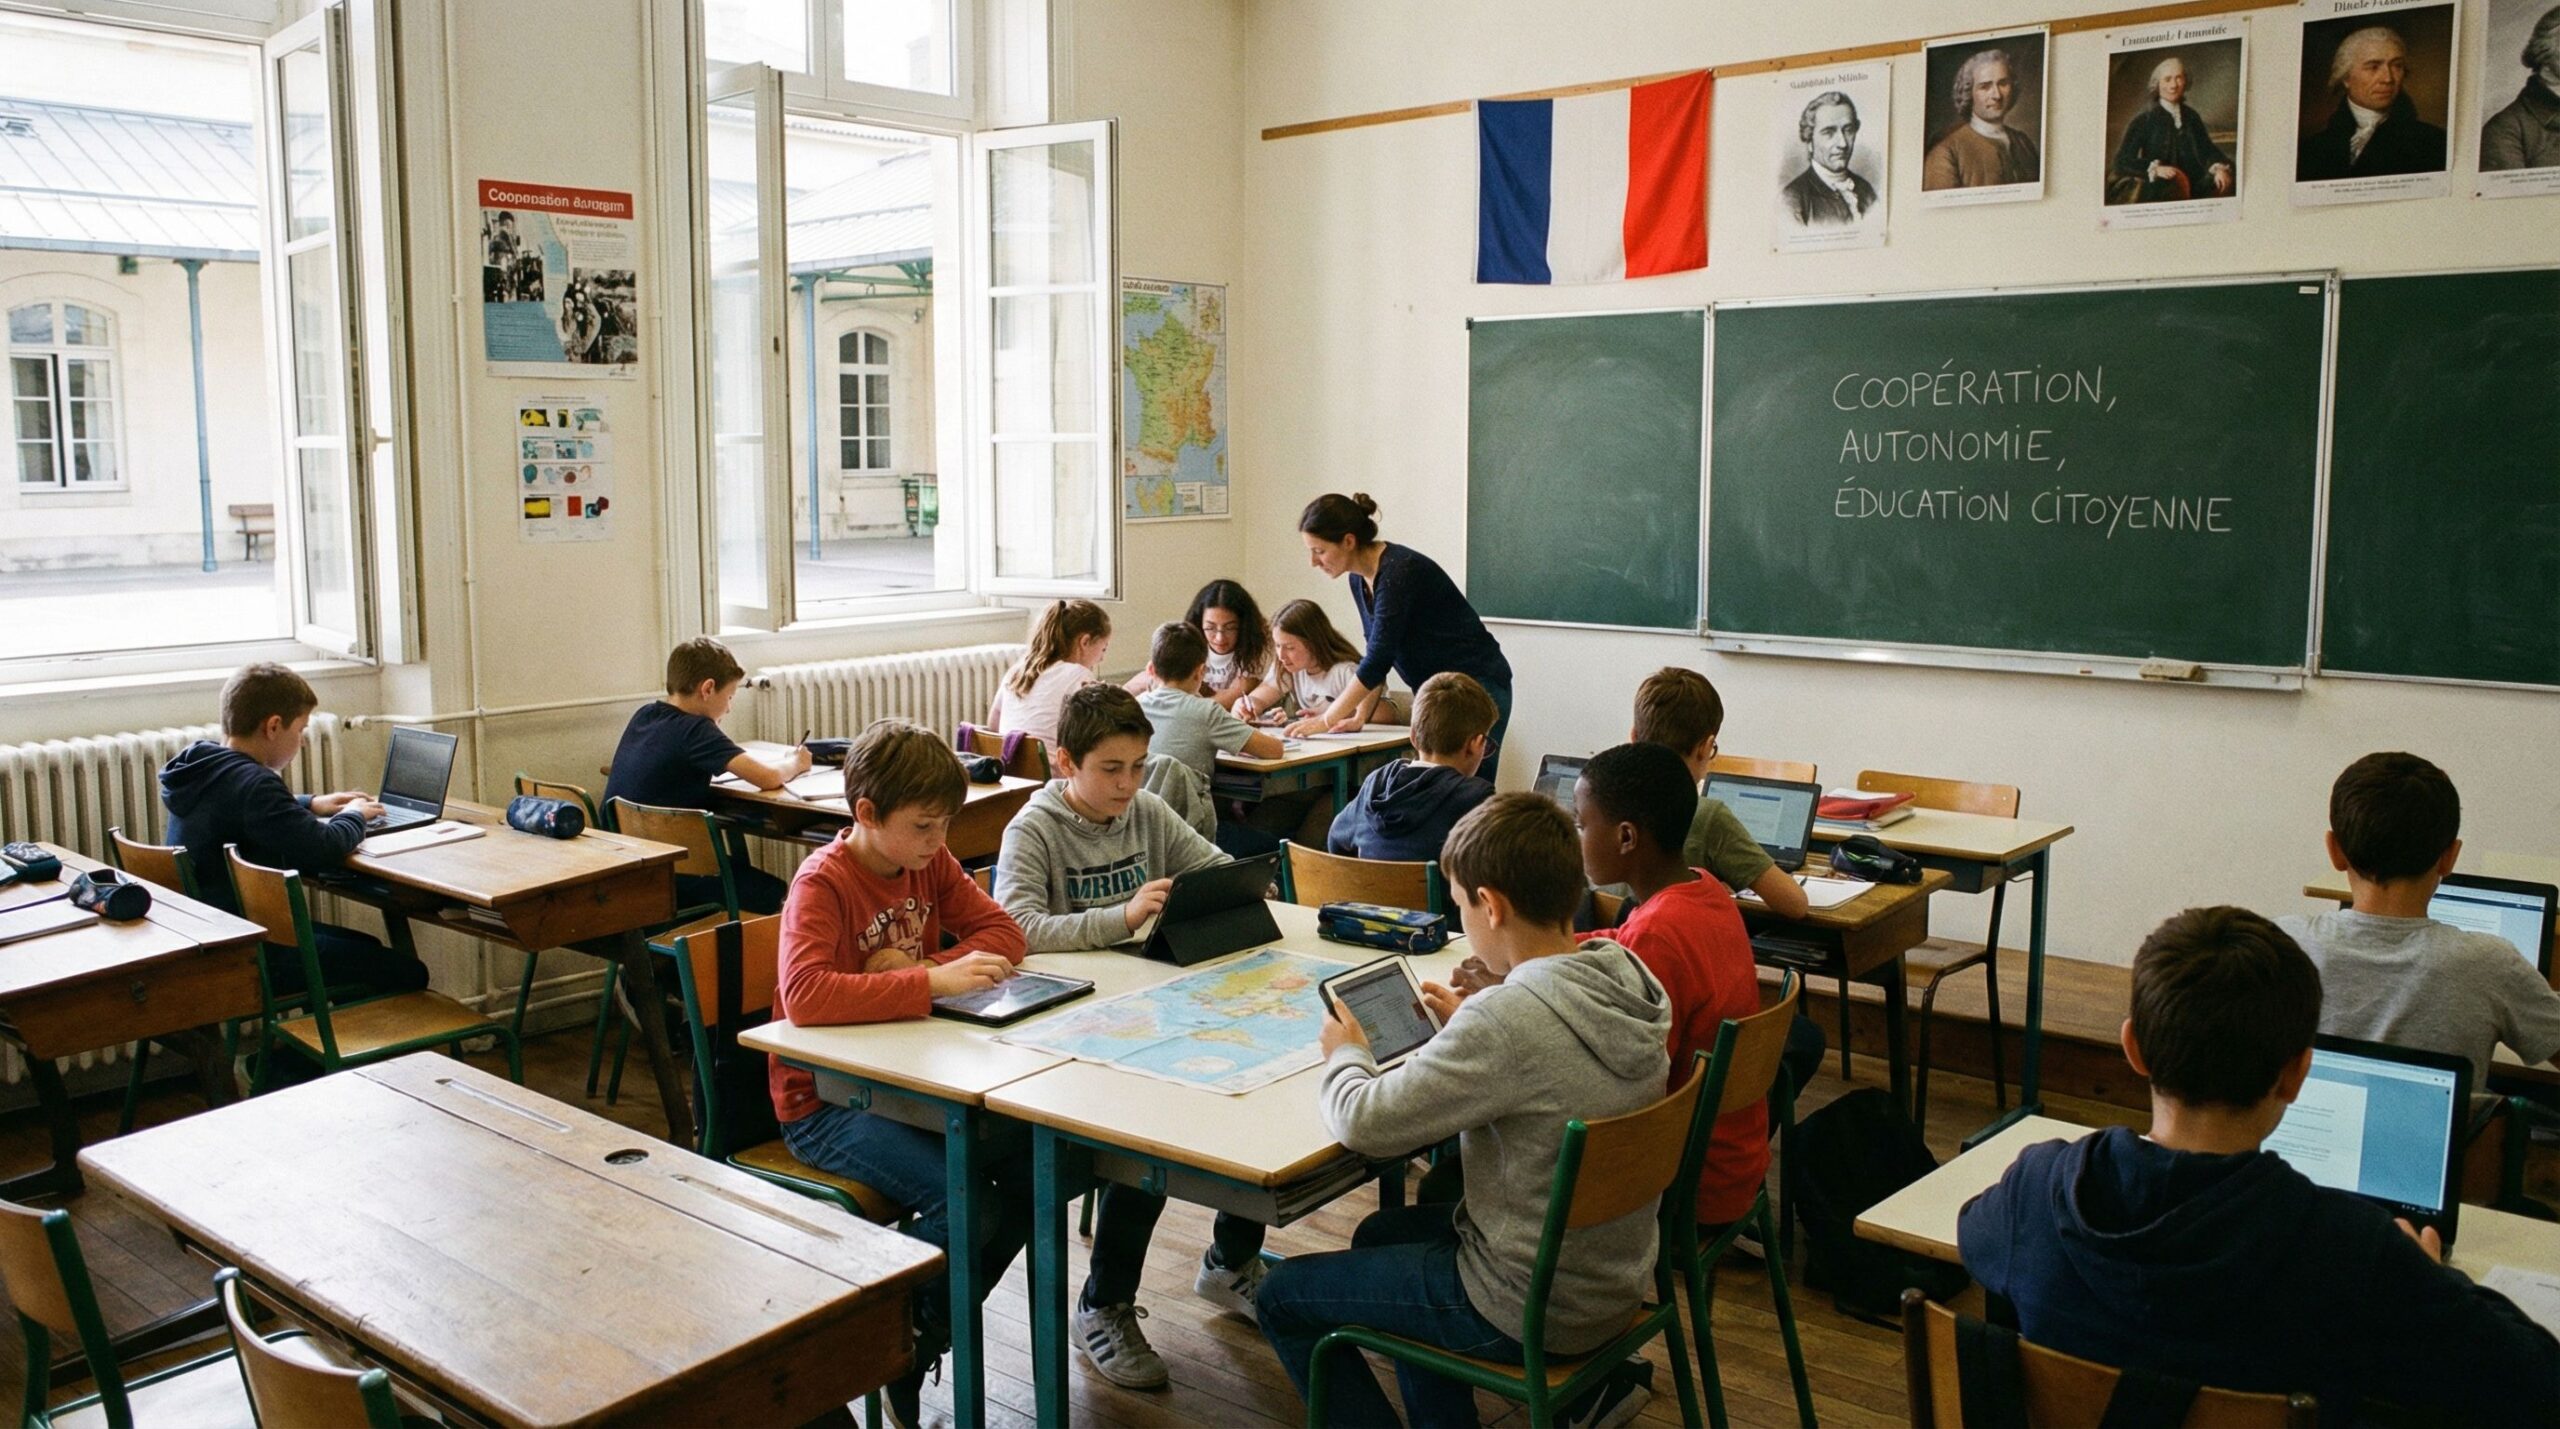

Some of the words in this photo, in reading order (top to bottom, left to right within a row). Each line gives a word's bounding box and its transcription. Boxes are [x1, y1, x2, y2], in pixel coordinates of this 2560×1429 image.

[1832, 358, 2116, 412] COOPÉRATION,
[1839, 424, 2066, 471] AUTONOMIE,
[1834, 476, 2009, 523] ÉDUCATION
[2031, 486, 2232, 539] CITOYENNE
